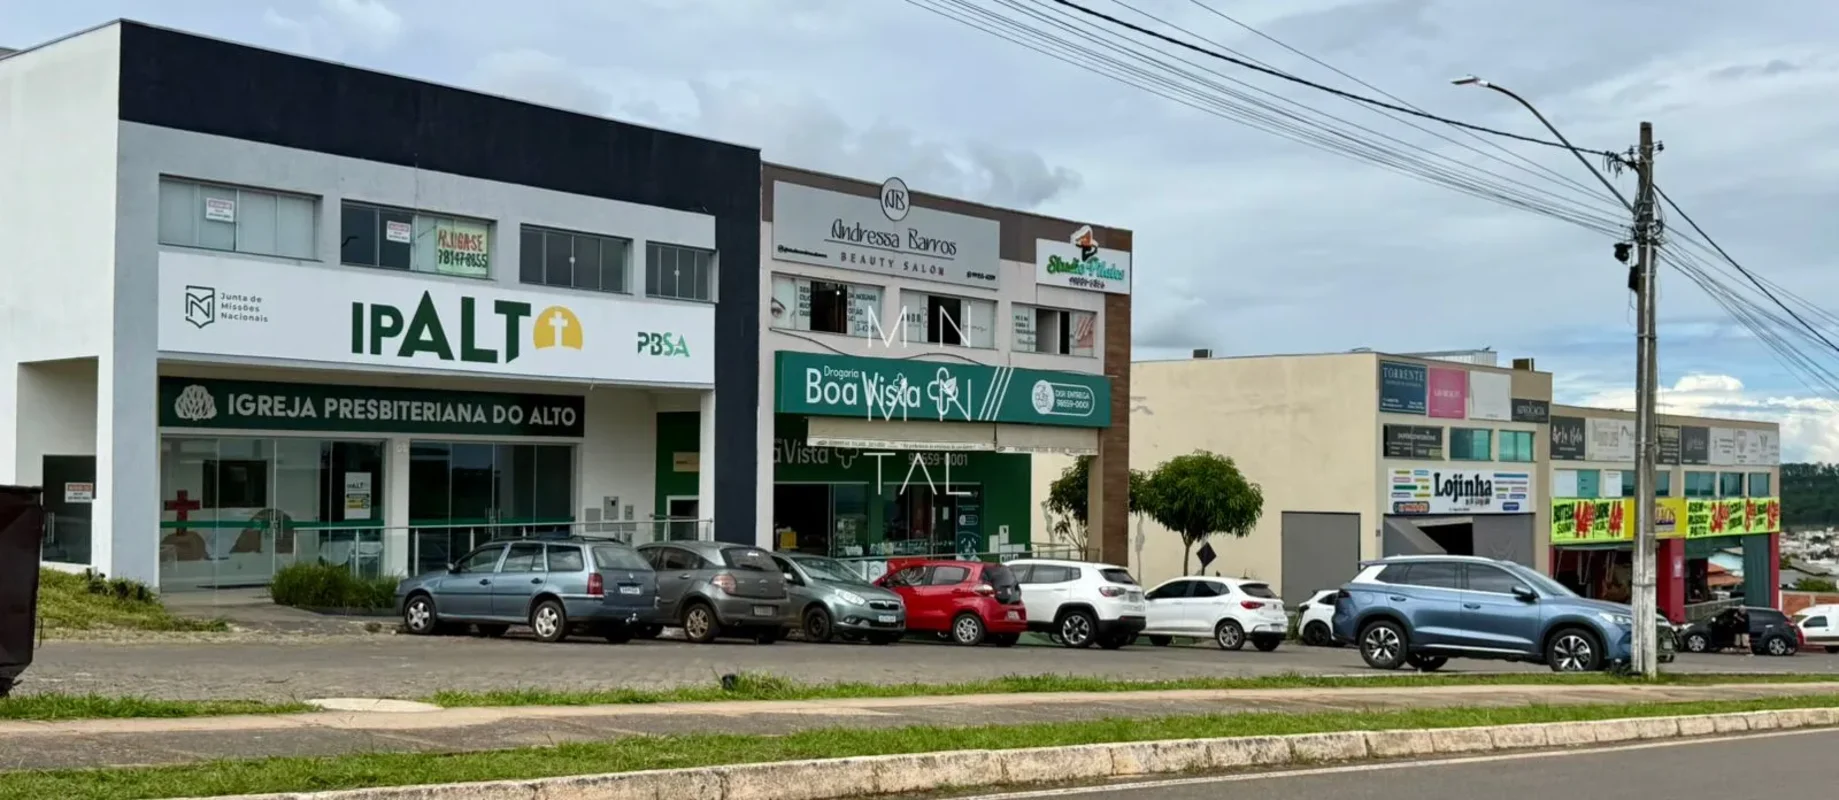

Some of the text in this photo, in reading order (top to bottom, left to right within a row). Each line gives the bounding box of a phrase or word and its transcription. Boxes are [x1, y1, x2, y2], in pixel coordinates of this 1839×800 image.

[831, 218, 957, 256] Andressa Barros
[840, 252, 945, 277] BEAUTY SALON
[221, 292, 262, 303] Junta de
[221, 303, 260, 312] Missões
[221, 312, 268, 322] Nacionais
[637, 331, 690, 357] PBSA
[824, 365, 859, 380] Drogaria
[1383, 367, 1425, 381] TORRENTE
[806, 368, 921, 408] Boa Vista
[228, 393, 577, 427] IGREJA PRESBITERIANA DO ALTO
[784, 439, 829, 464] Vista
[1433, 472, 1492, 503] Lojinha
